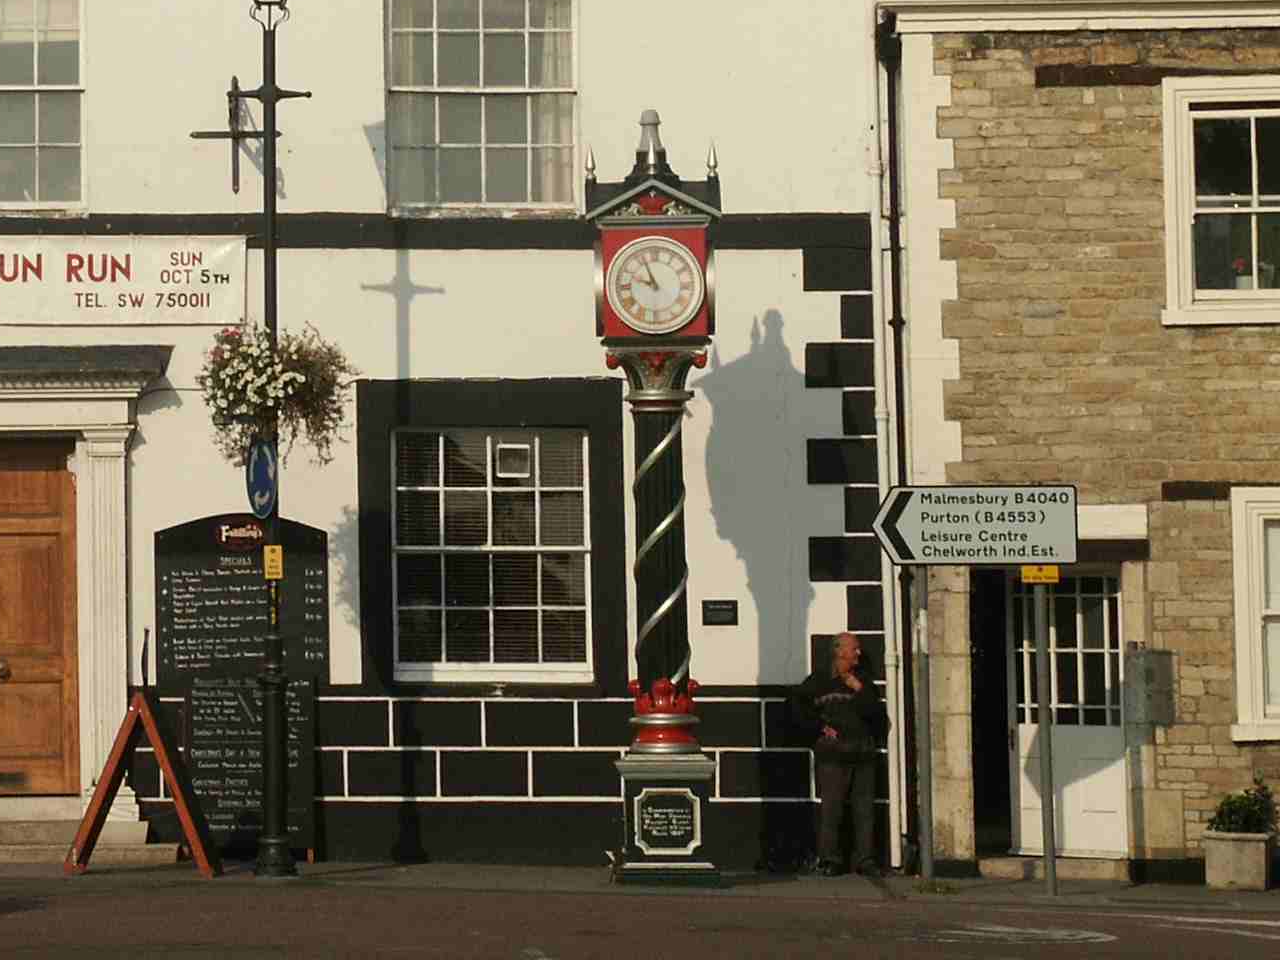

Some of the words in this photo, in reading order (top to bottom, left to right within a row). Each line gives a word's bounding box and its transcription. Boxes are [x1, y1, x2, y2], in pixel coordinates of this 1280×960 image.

[170, 251, 203, 267] SUN
[65, 253, 132, 283] RUN
[160, 269, 193, 285] OCT
[75, 292, 108, 309] TEL.
[118, 292, 145, 308] SW
[920, 493, 1009, 506] Malmesbury
[1014, 492, 1070, 504] B4040
[921, 511, 970, 523] Purton
[921, 530, 973, 542] Leisure
[978, 530, 1028, 542] Centre
[922, 544, 998, 557] Chelworth
